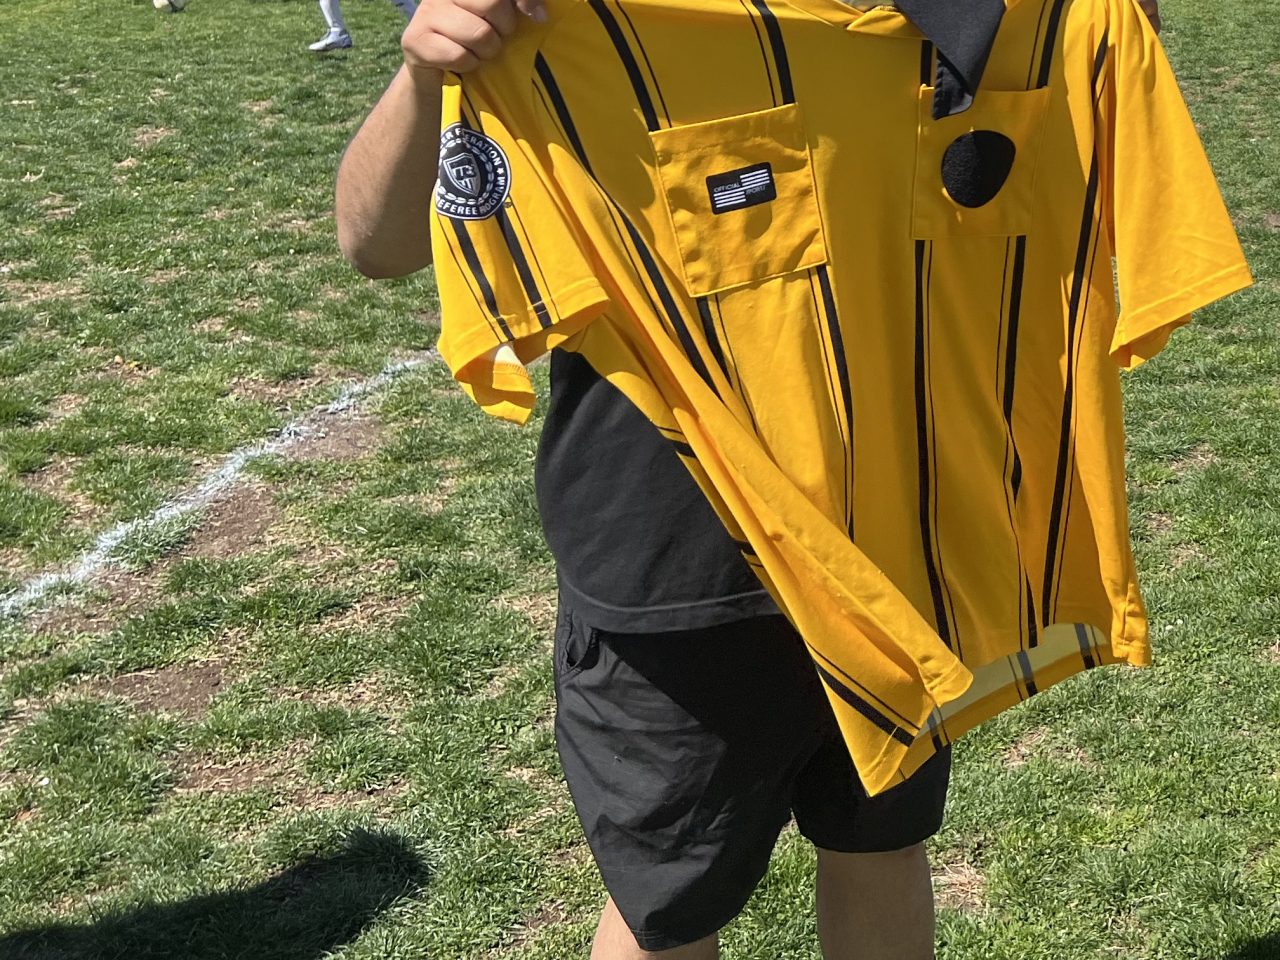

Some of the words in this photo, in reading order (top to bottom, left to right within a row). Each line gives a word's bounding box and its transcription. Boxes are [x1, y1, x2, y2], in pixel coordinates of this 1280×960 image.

[437, 198, 478, 216] EFEREE
[479, 176, 506, 214] ROGRAM
[713, 182, 740, 193] OFFICIAL
